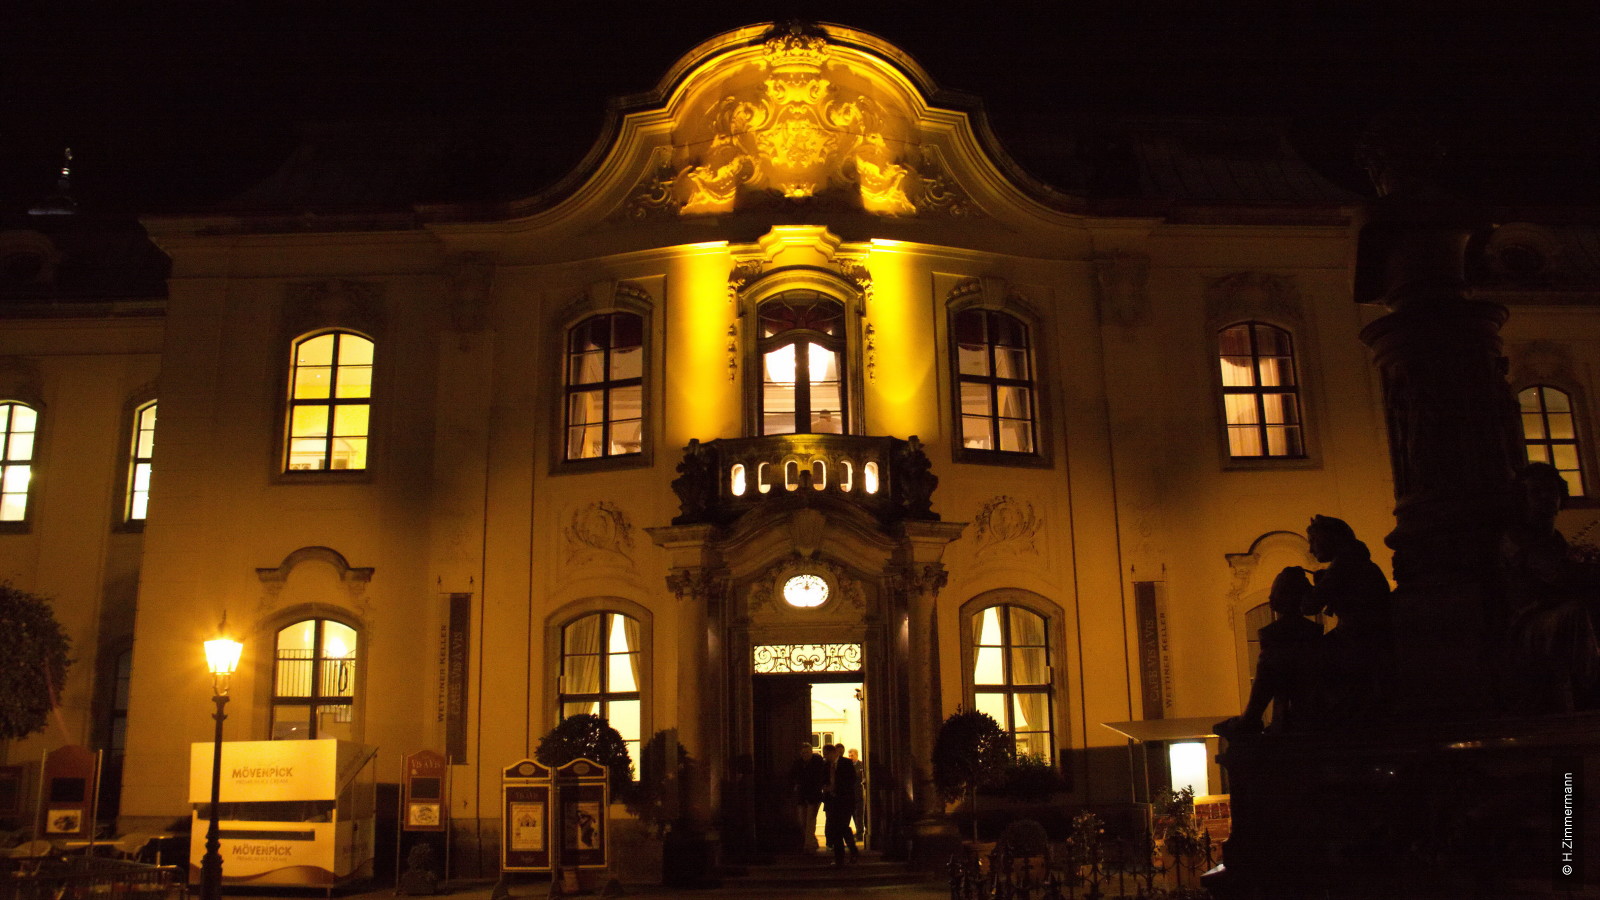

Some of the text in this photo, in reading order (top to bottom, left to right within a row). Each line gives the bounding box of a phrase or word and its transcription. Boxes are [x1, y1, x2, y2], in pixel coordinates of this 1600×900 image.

[439, 624, 447, 665] KELLER
[1160, 612, 1168, 651] KELLER
[231, 766, 293, 778] MÖVENPICK
[232, 843, 292, 856] MÖVENPICK
